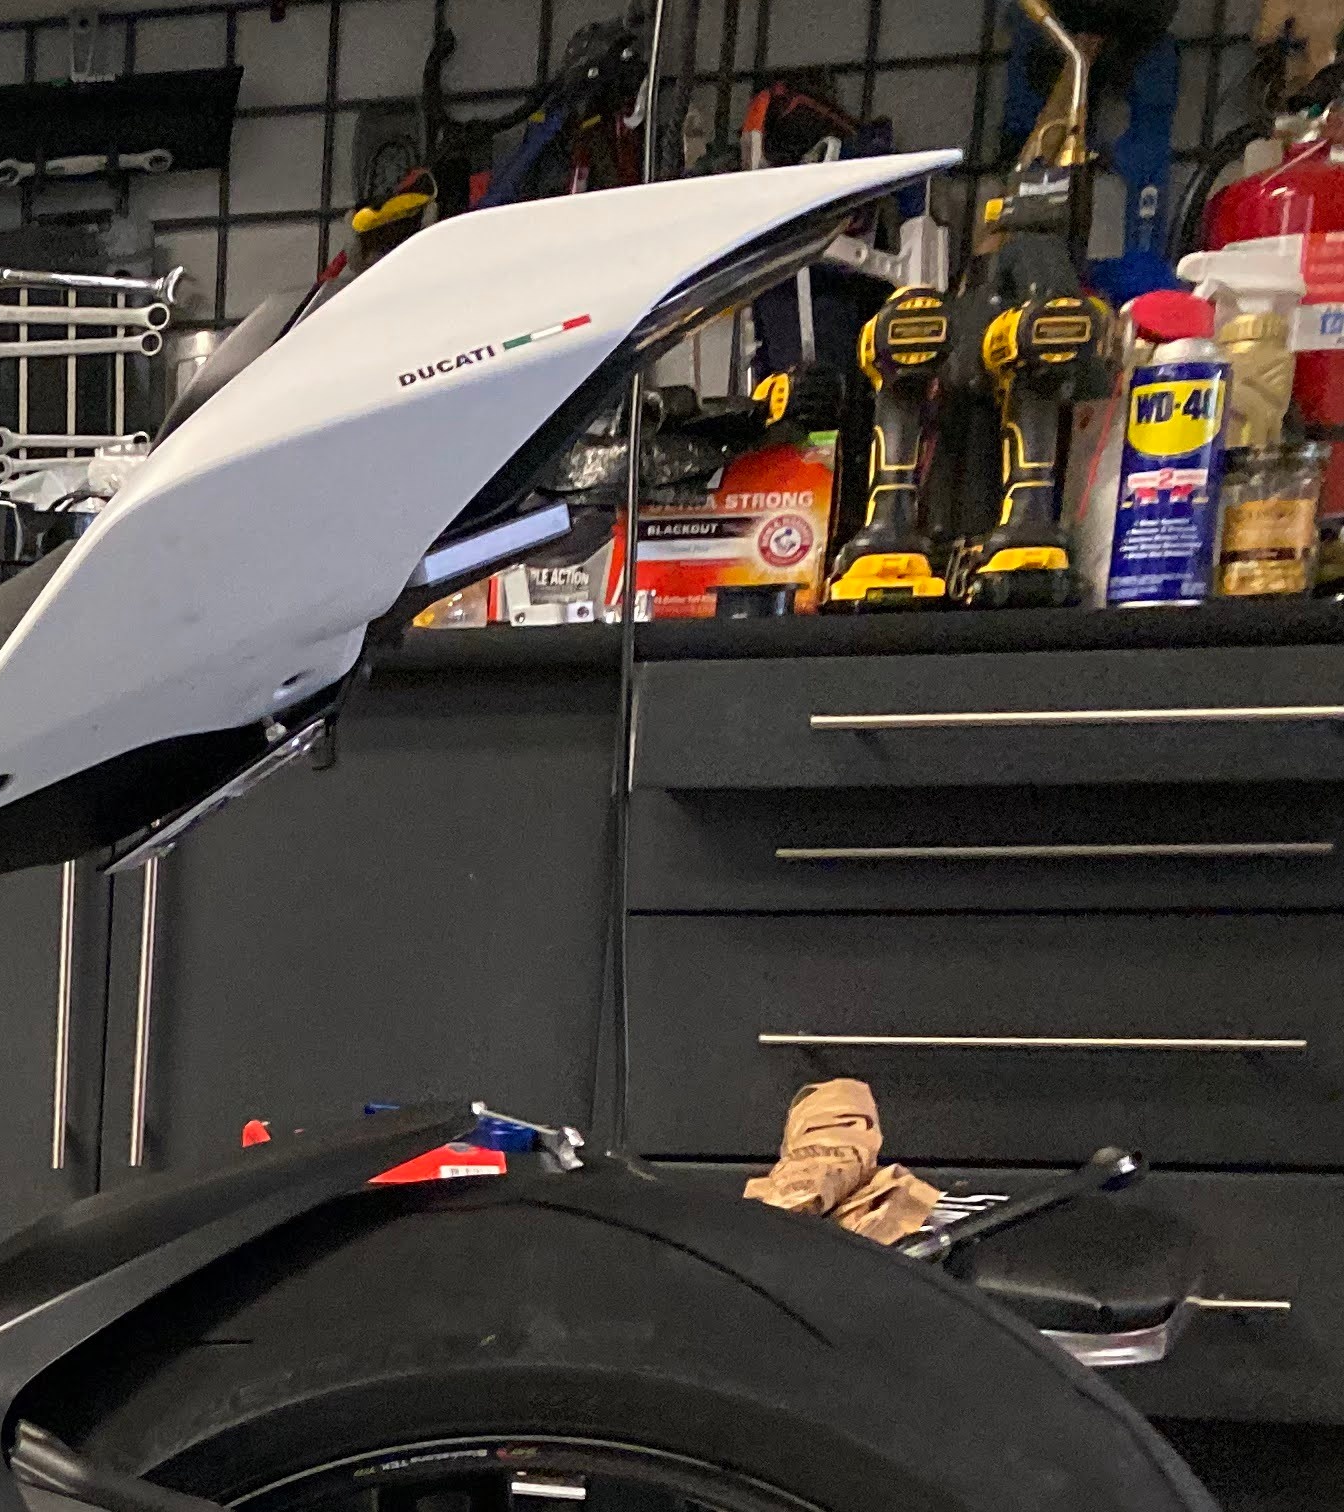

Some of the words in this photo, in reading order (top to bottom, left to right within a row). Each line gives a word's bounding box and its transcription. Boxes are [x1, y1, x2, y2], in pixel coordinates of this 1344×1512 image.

[398, 345, 495, 386] DUCATI
[724, 491, 814, 510] STRONG
[647, 522, 718, 536] BLACKOUT
[550, 567, 590, 585] ACTION
